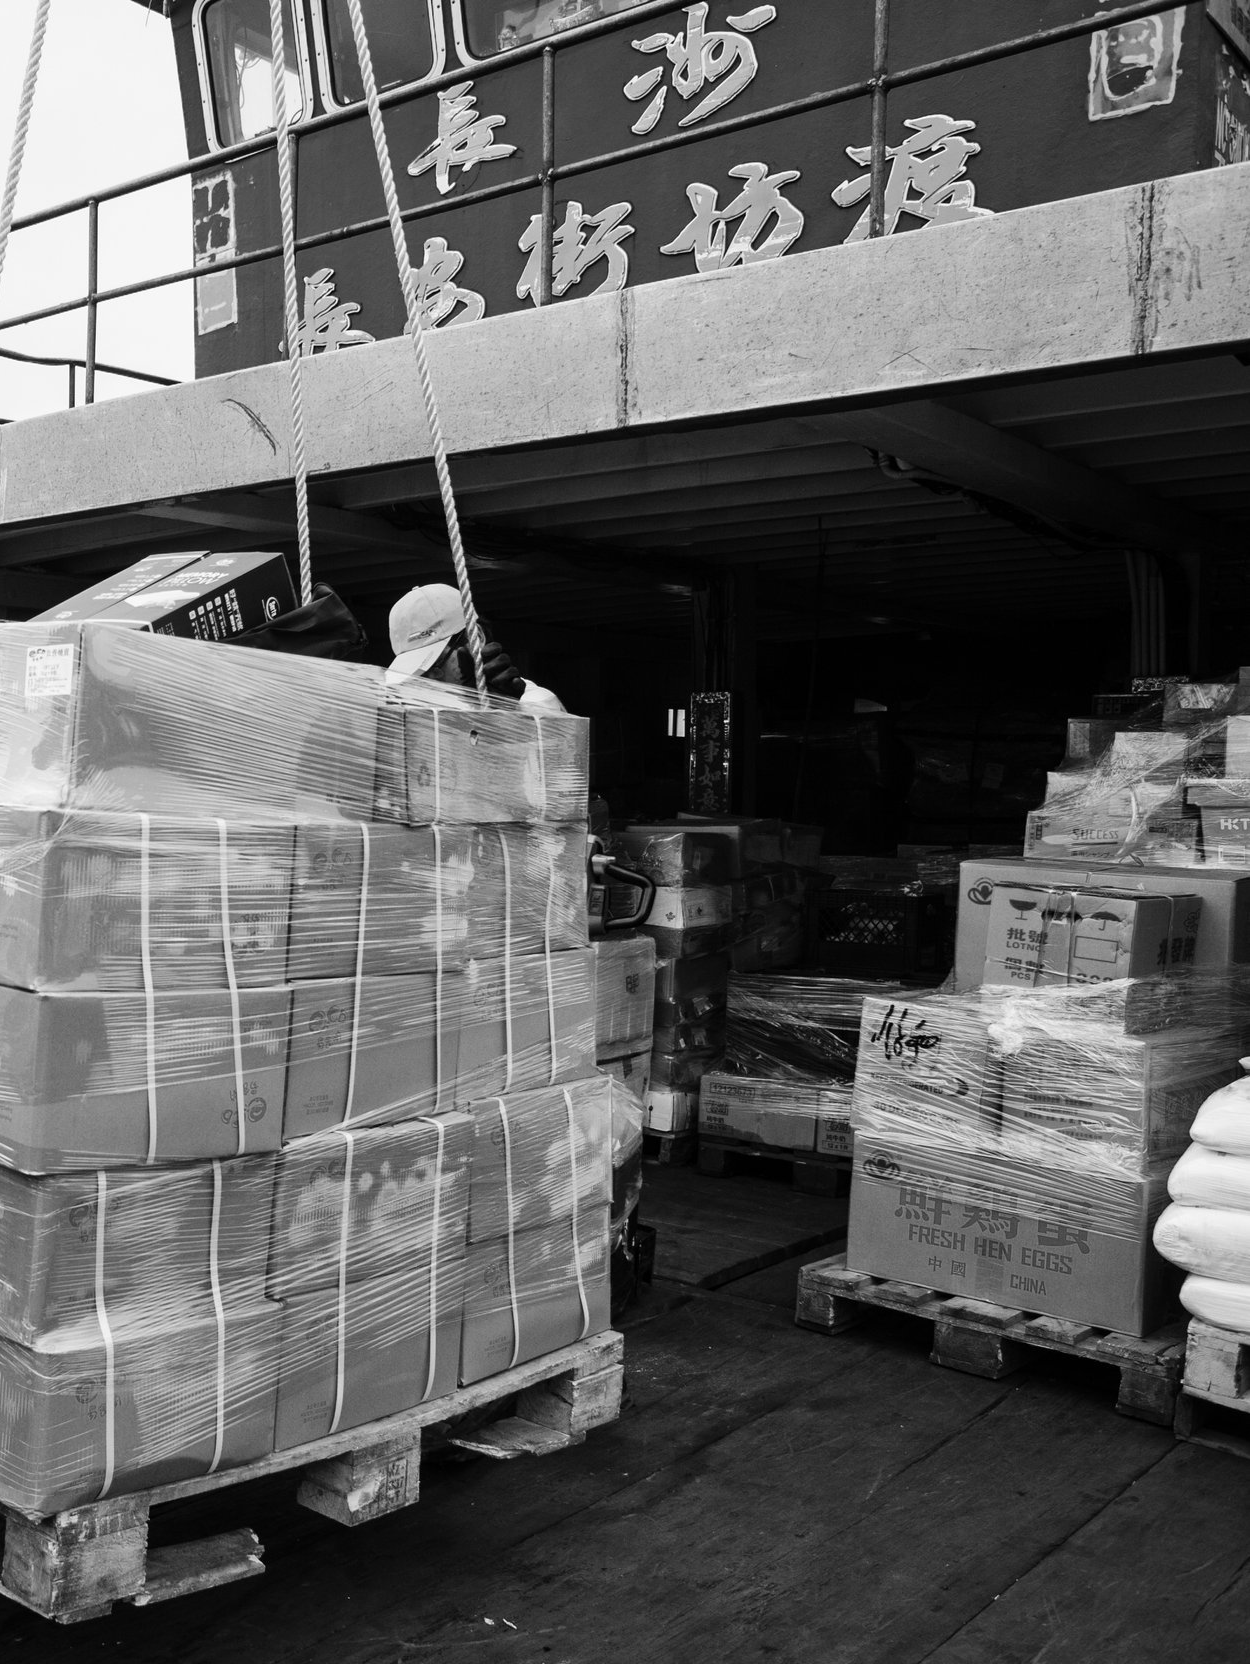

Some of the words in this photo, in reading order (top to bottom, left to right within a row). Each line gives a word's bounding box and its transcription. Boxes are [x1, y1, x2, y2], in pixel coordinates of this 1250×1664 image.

[1006, 927, 1048, 945] 批號
[1010, 971, 1031, 981] PCS
[908, 1223, 966, 1251] FRESH
[974, 1236, 1012, 1262] HEN
[1021, 1246, 1073, 1275] EGGS
[928, 1255, 967, 1278] 中國
[1009, 1273, 1047, 1296] CHINA
